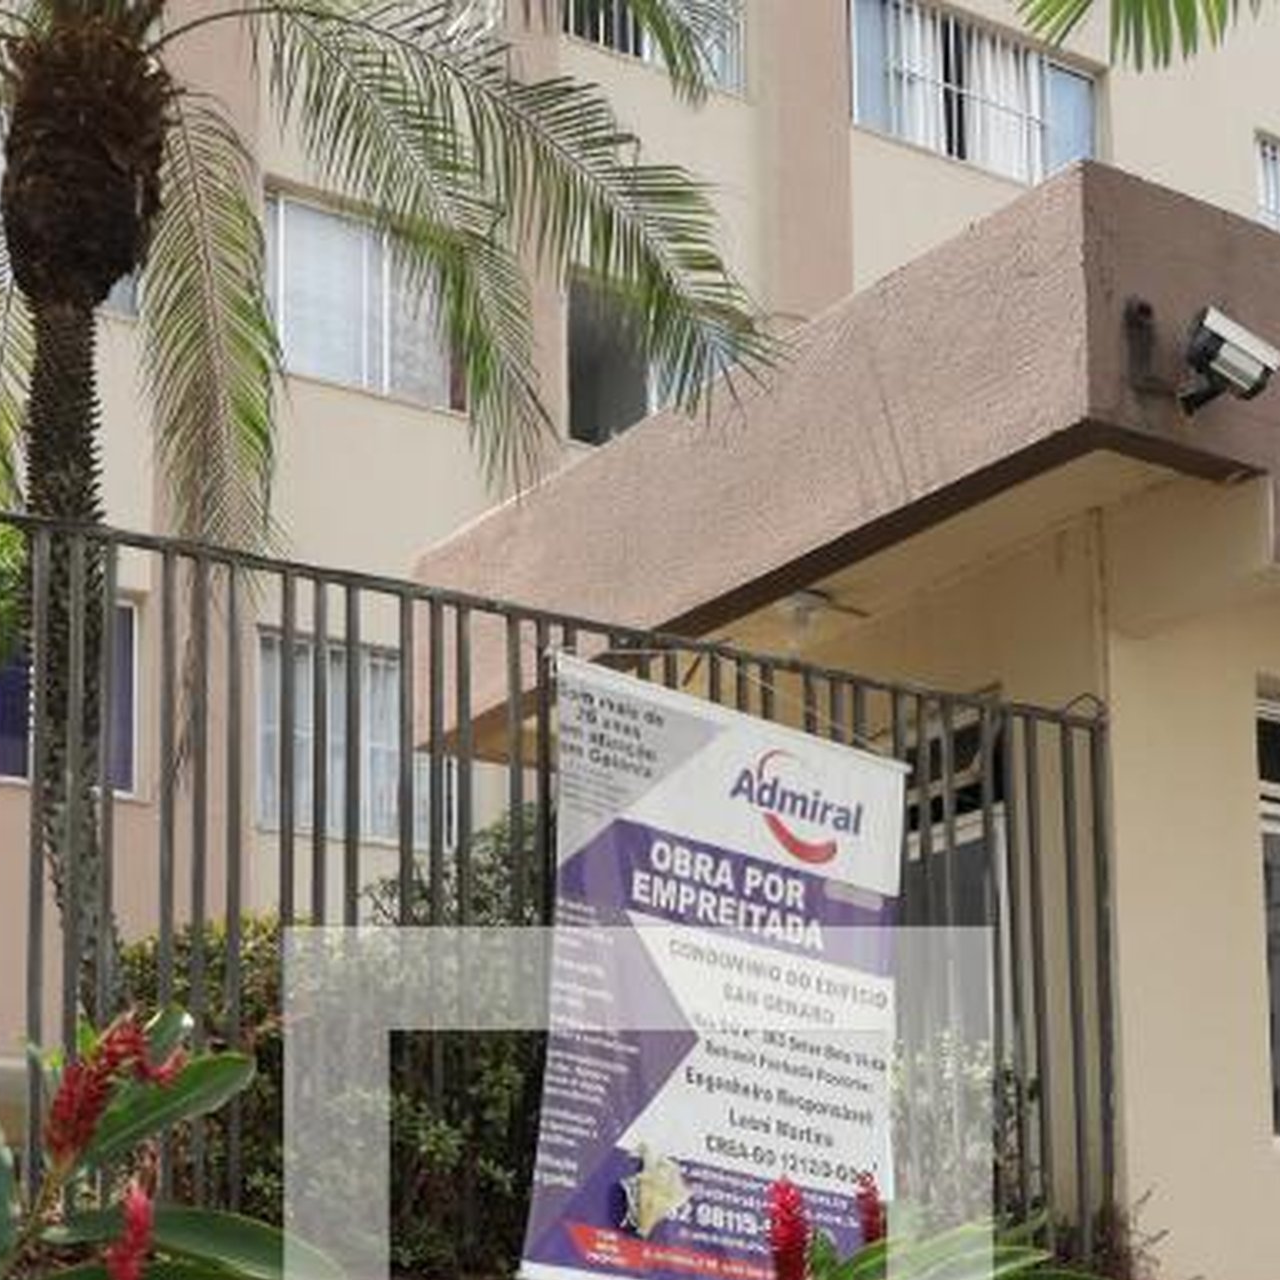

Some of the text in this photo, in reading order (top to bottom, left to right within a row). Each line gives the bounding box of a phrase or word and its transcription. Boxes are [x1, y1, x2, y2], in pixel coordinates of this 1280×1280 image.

[730, 769, 862, 836] Admiral
[650, 840, 806, 911] OBRA POR
[631, 870, 823, 952] EMPREITADA
[723, 983, 759, 1006] SAN
[785, 970, 812, 991] DO
[685, 1066, 773, 1101] Engenheiro
